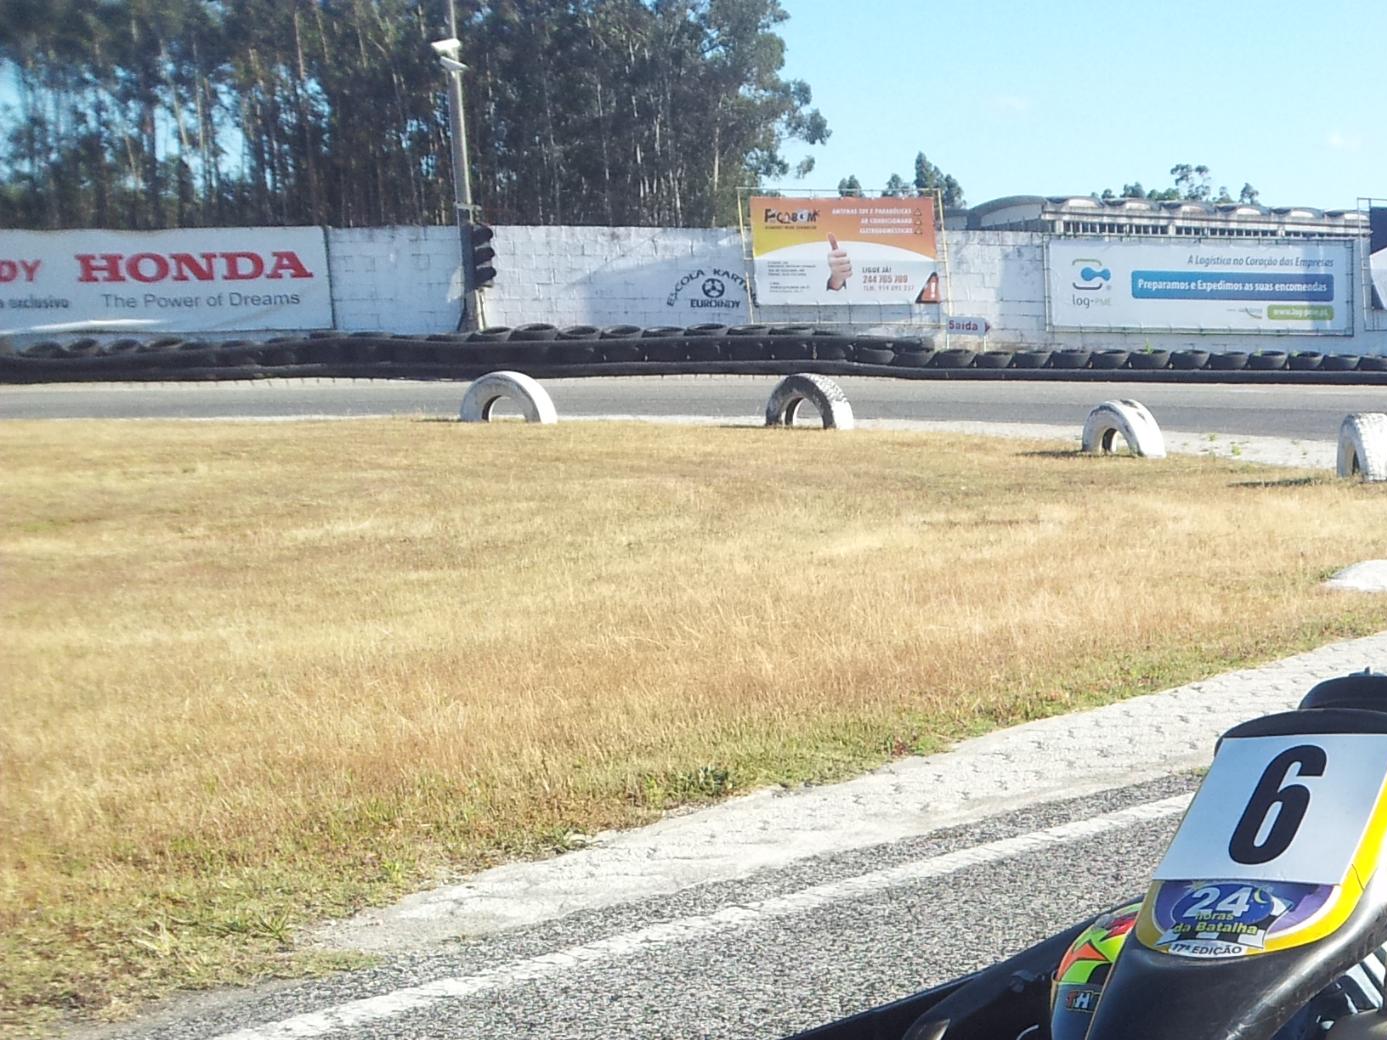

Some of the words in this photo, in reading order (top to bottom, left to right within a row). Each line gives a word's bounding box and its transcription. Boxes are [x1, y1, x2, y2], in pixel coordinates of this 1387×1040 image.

[74, 251, 314, 284] HONDA
[1195, 256, 1232, 268] Logística
[1233, 257, 1243, 266] no
[1245, 256, 1278, 268] Coração
[1279, 257, 1293, 266] das
[1294, 257, 1334, 269] Empresas
[666, 268, 705, 308] ESCOLA
[1137, 279, 1189, 291] Preparamos
[1190, 282, 1196, 290] e
[1197, 280, 1243, 293] Expedimos
[1244, 283, 1254, 291] as
[1255, 283, 1273, 291] suas
[1274, 282, 1327, 292] encomendas
[102, 294, 138, 309] The
[143, 294, 201, 309] Power
[206, 292, 223, 308] of
[229, 291, 301, 307] Dreams
[1228, 744, 1327, 865] 6
[1182, 885, 1253, 918] 24
[1173, 922, 1191, 934] da
[1195, 921, 1258, 935] Batalha
[1191, 945, 1243, 956] EDIÇÃO
